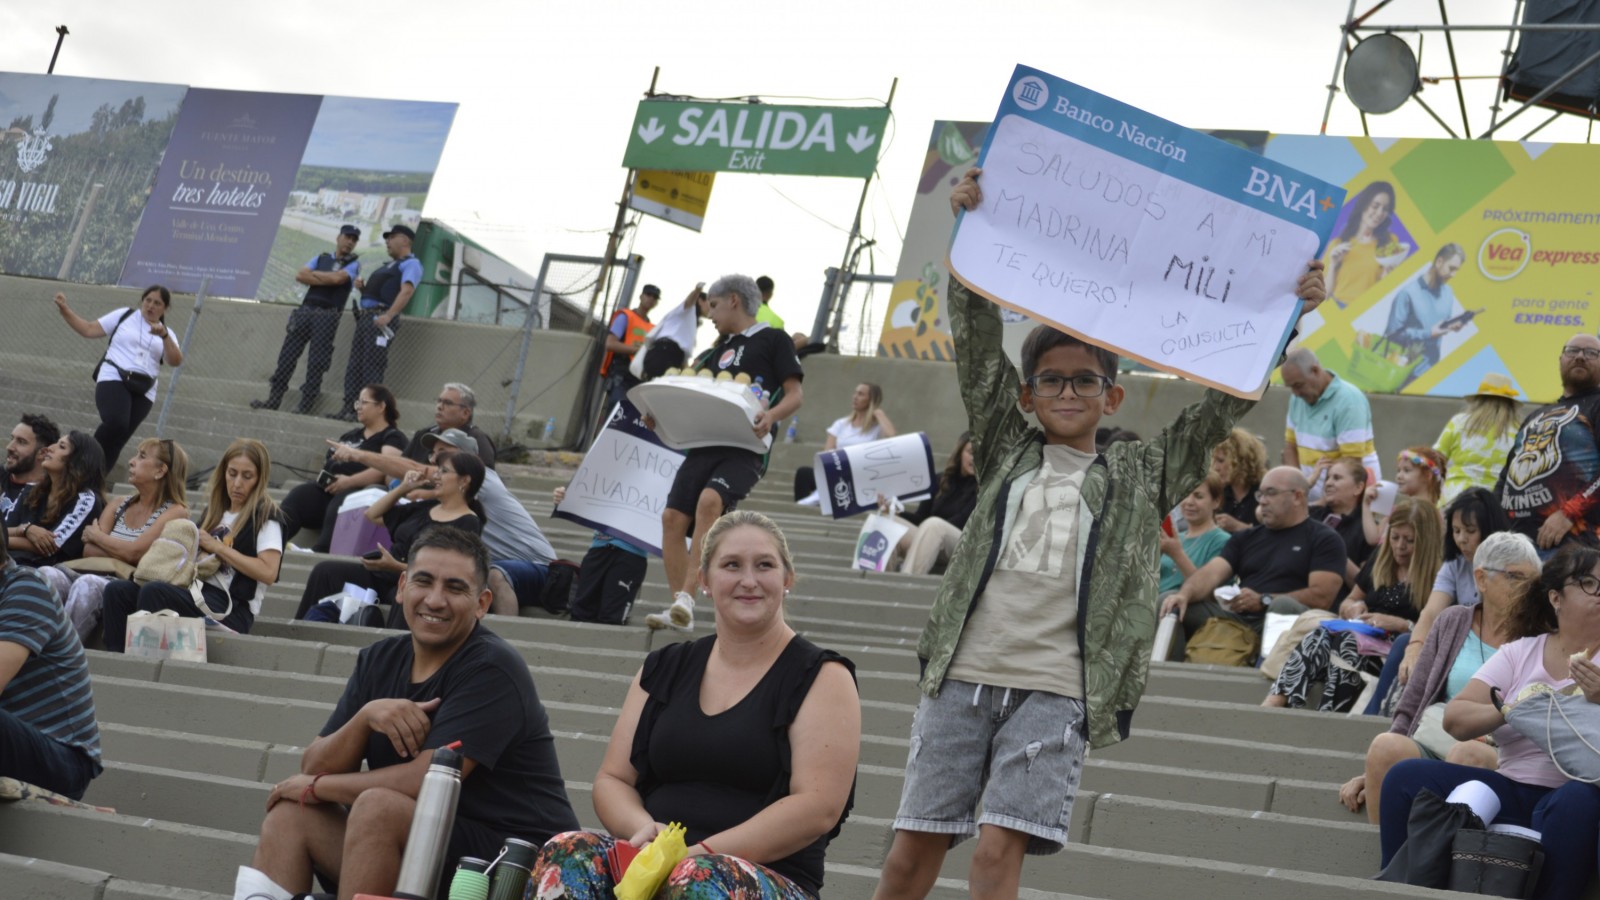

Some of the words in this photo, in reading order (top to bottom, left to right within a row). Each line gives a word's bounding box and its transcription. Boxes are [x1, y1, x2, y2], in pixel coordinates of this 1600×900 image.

[672, 107, 836, 152] SALIDA
[1052, 96, 1114, 133] Banco
[1116, 121, 1187, 163] Nación
[180, 159, 206, 180] Un
[210, 162, 272, 189] destino,
[728, 150, 766, 170] Exit
[17, 182, 59, 213] VIGIL
[172, 182, 206, 203] tres
[206, 182, 266, 208] hoteles
[1016, 142, 1167, 221] SALUDOS
[1197, 212, 1214, 238] A
[993, 189, 1129, 264] MADRINA
[993, 243, 1028, 270] TE
[1488, 244, 1524, 261] Vea
[1533, 249, 1600, 266] express
[1512, 296, 1545, 309] para
[1549, 298, 1589, 311] gente
[1161, 311, 1188, 328] LA
[1514, 313, 1585, 326] EXPRESS.
[1161, 320, 1256, 355] CONSULTA
